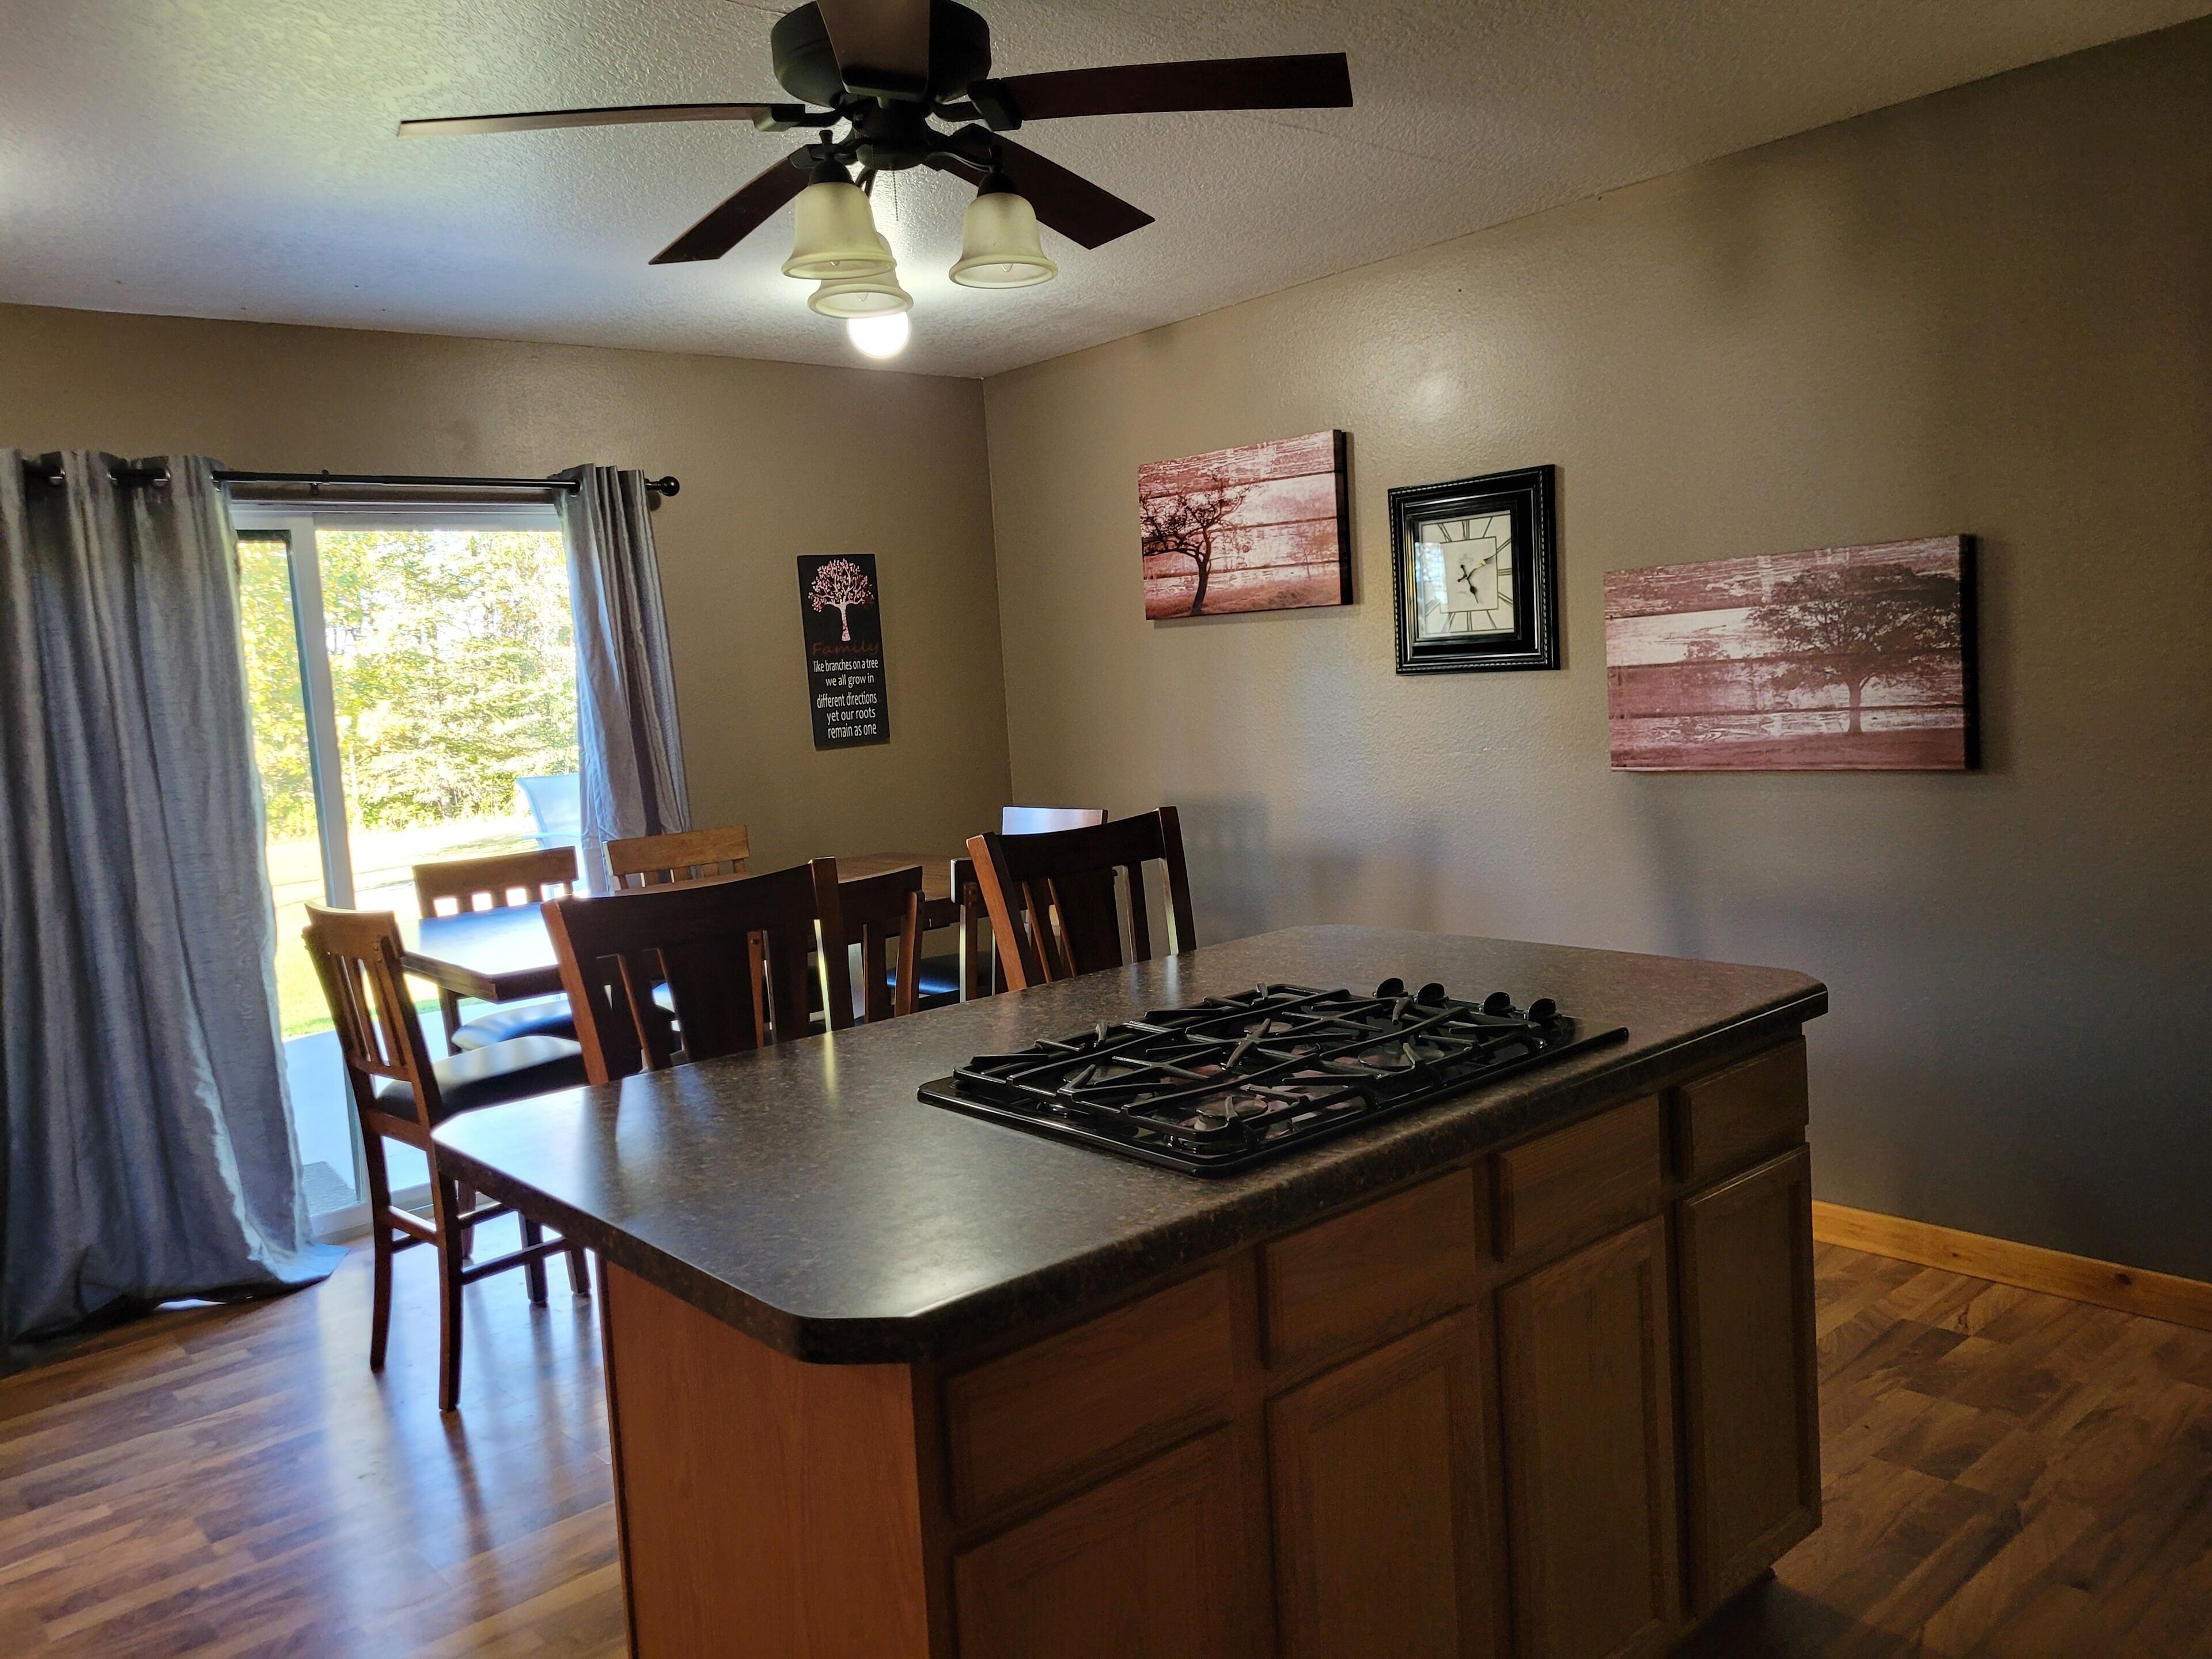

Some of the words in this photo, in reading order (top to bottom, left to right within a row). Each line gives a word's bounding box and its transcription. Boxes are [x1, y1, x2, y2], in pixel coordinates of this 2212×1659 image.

[812, 641, 878, 656] Family
[813, 660, 824, 672] like
[825, 658, 852, 672] branches
[853, 661, 861, 669] on
[862, 660, 866, 669] a
[866, 658, 878, 669] tree
[825, 677, 837, 687] we
[838, 674, 846, 686] all
[848, 675, 866, 688] grow
[867, 673, 874, 683] in
[817, 693, 846, 709] different
[846, 691, 877, 706] directions
[827, 710, 839, 726] yet
[840, 710, 855, 721] our
[855, 707, 876, 719] roots
[828, 723, 853, 739] remain
[854, 725, 862, 736] as
[863, 723, 877, 736] one
